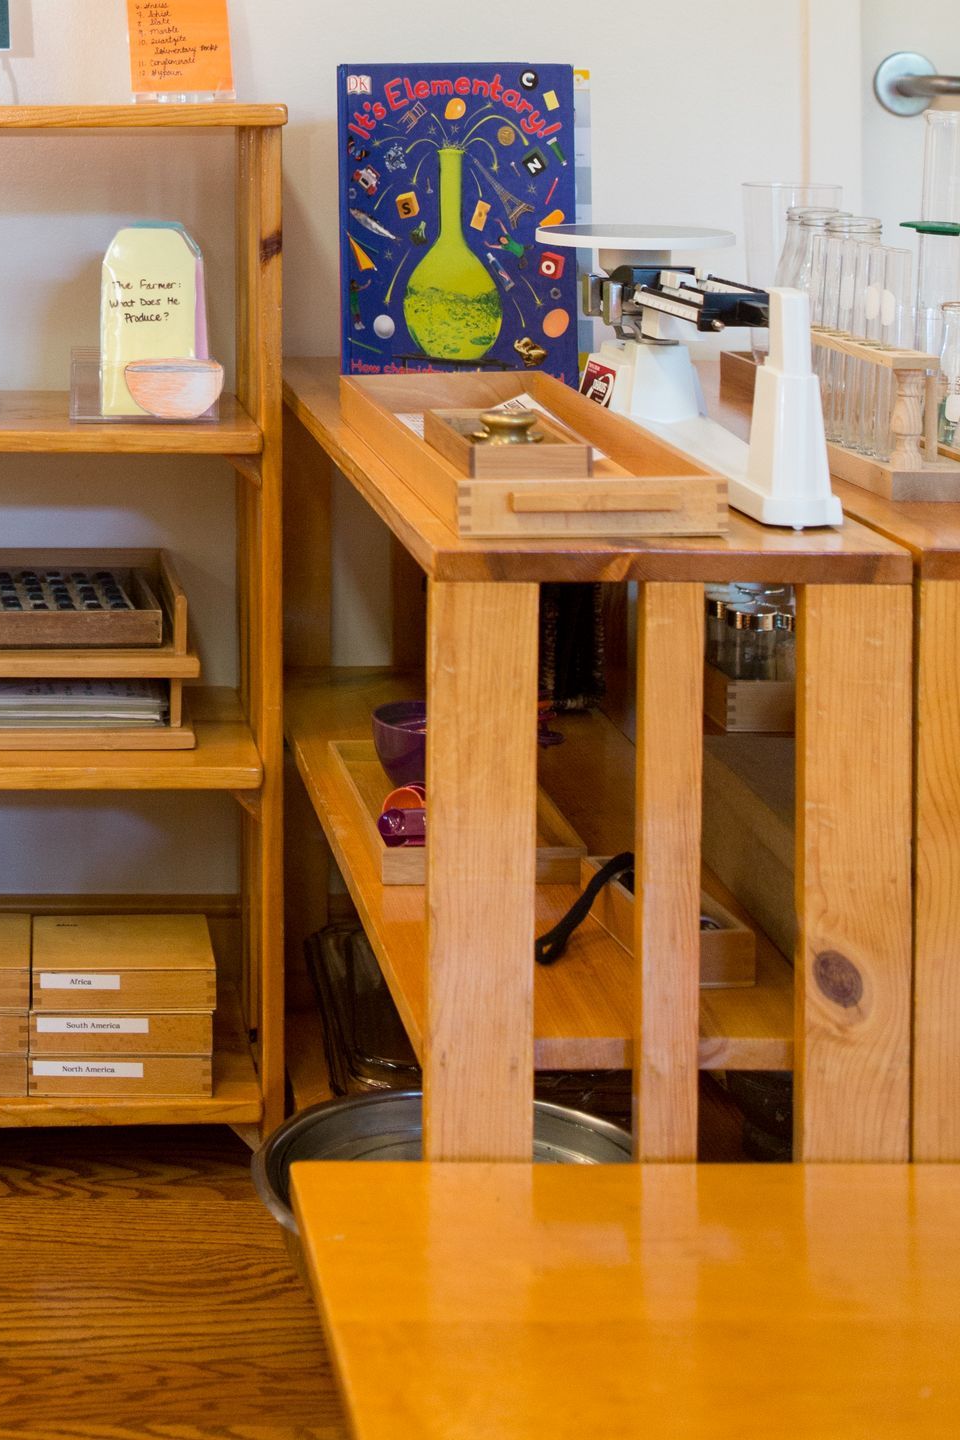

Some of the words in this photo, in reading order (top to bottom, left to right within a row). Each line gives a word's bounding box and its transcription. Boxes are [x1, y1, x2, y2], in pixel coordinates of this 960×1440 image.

[348, 77, 369, 91] DK
[348, 101, 387, 140] It's
[384, 73, 562, 138] Elementary!
[140, 298, 161, 306] Does
[167, 297, 180, 305] He
[351, 359, 380, 373] How
[62, 1065, 83, 1073] North
[85, 1066, 115, 1074] America
